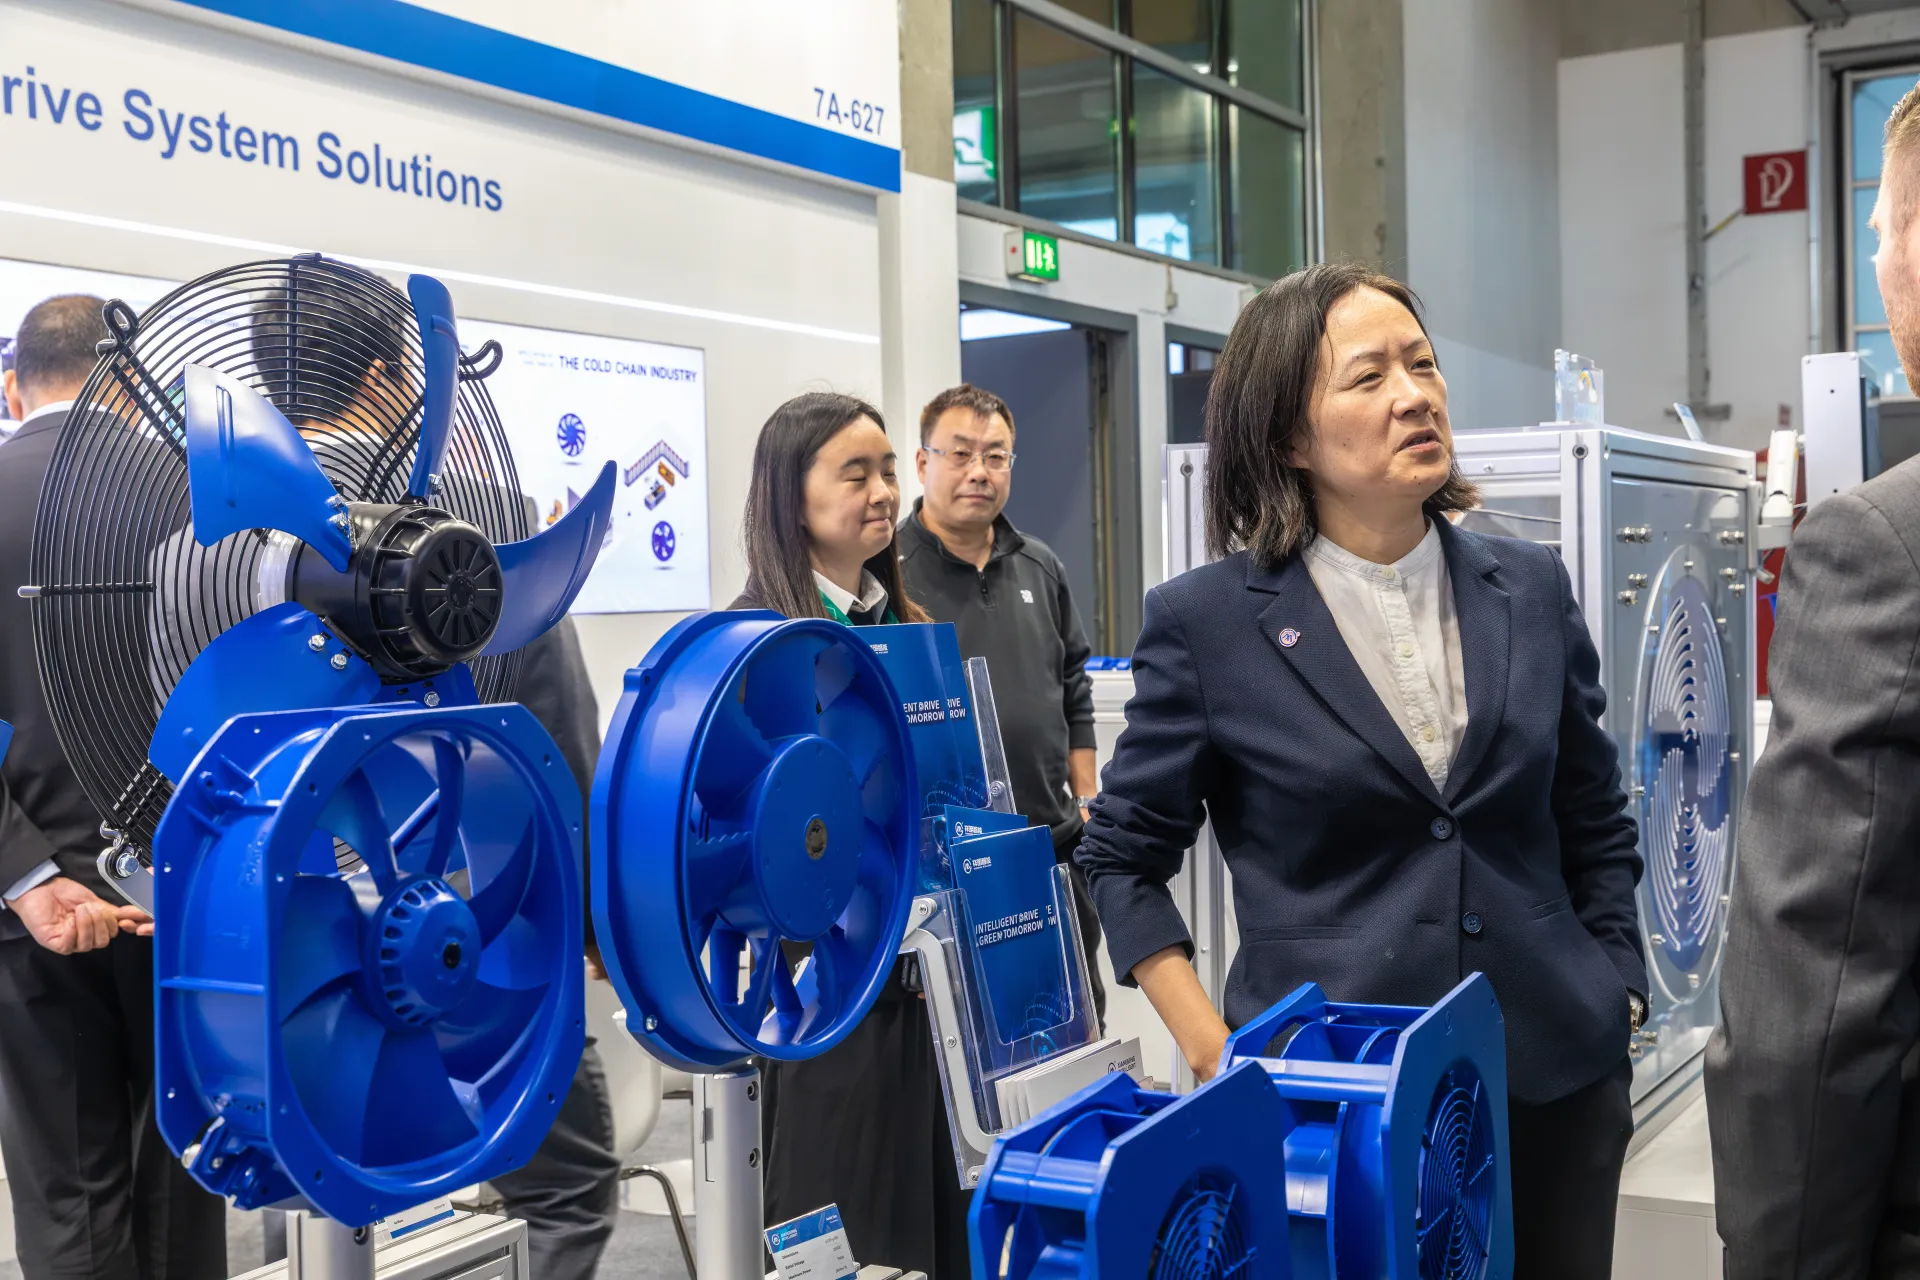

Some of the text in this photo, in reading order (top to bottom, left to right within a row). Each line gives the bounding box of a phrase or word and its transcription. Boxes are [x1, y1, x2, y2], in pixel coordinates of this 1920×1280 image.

[813, 87, 884, 136] 7A-627
[122, 88, 299, 171] System
[316, 131, 503, 212] Solutions
[559, 355, 580, 370] THE
[583, 358, 612, 373] COLD
[615, 361, 647, 376] CHAIN
[650, 365, 698, 383] INDUSTRY
[975, 913, 1018, 935] INTELLIGENT
[979, 930, 1003, 946] GREEN
[1003, 919, 1044, 939] TOMORROW
